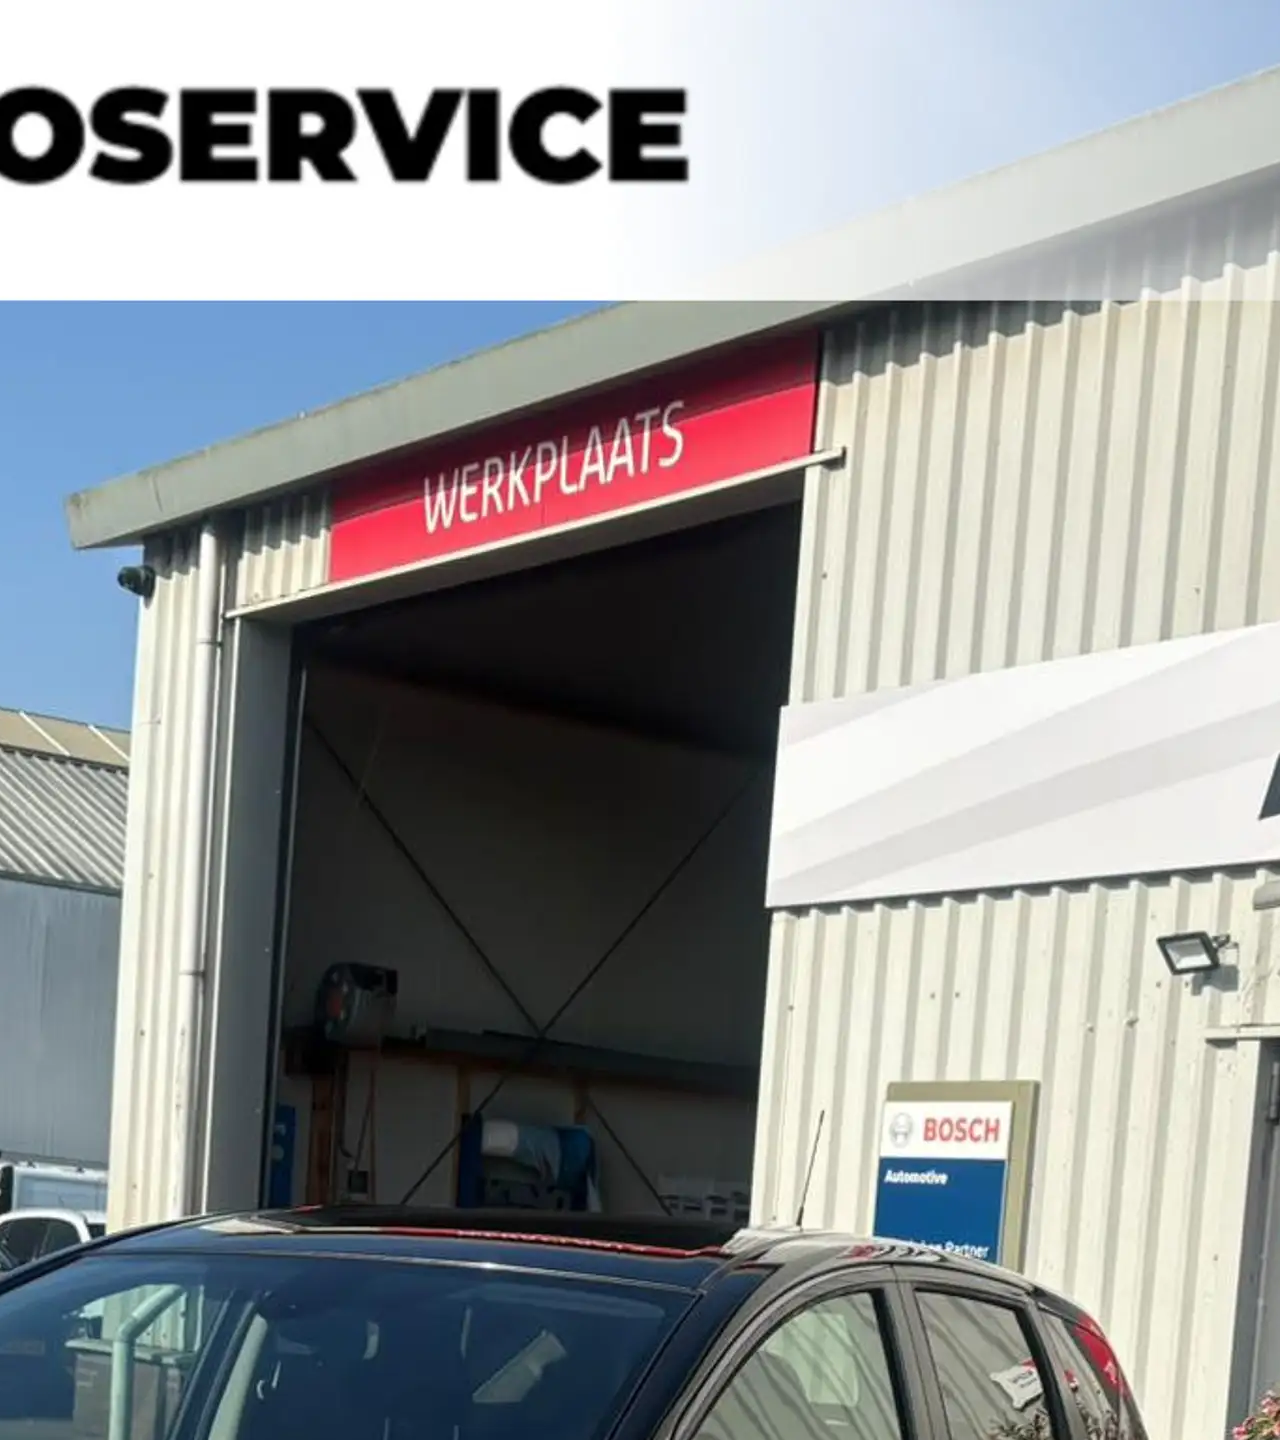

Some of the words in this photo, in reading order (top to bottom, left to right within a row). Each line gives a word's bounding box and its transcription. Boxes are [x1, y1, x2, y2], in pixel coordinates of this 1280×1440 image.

[424, 400, 684, 533] WERKPLAATS
[923, 1118, 1000, 1142] BOSCH
[884, 1169, 948, 1185] Automotive
